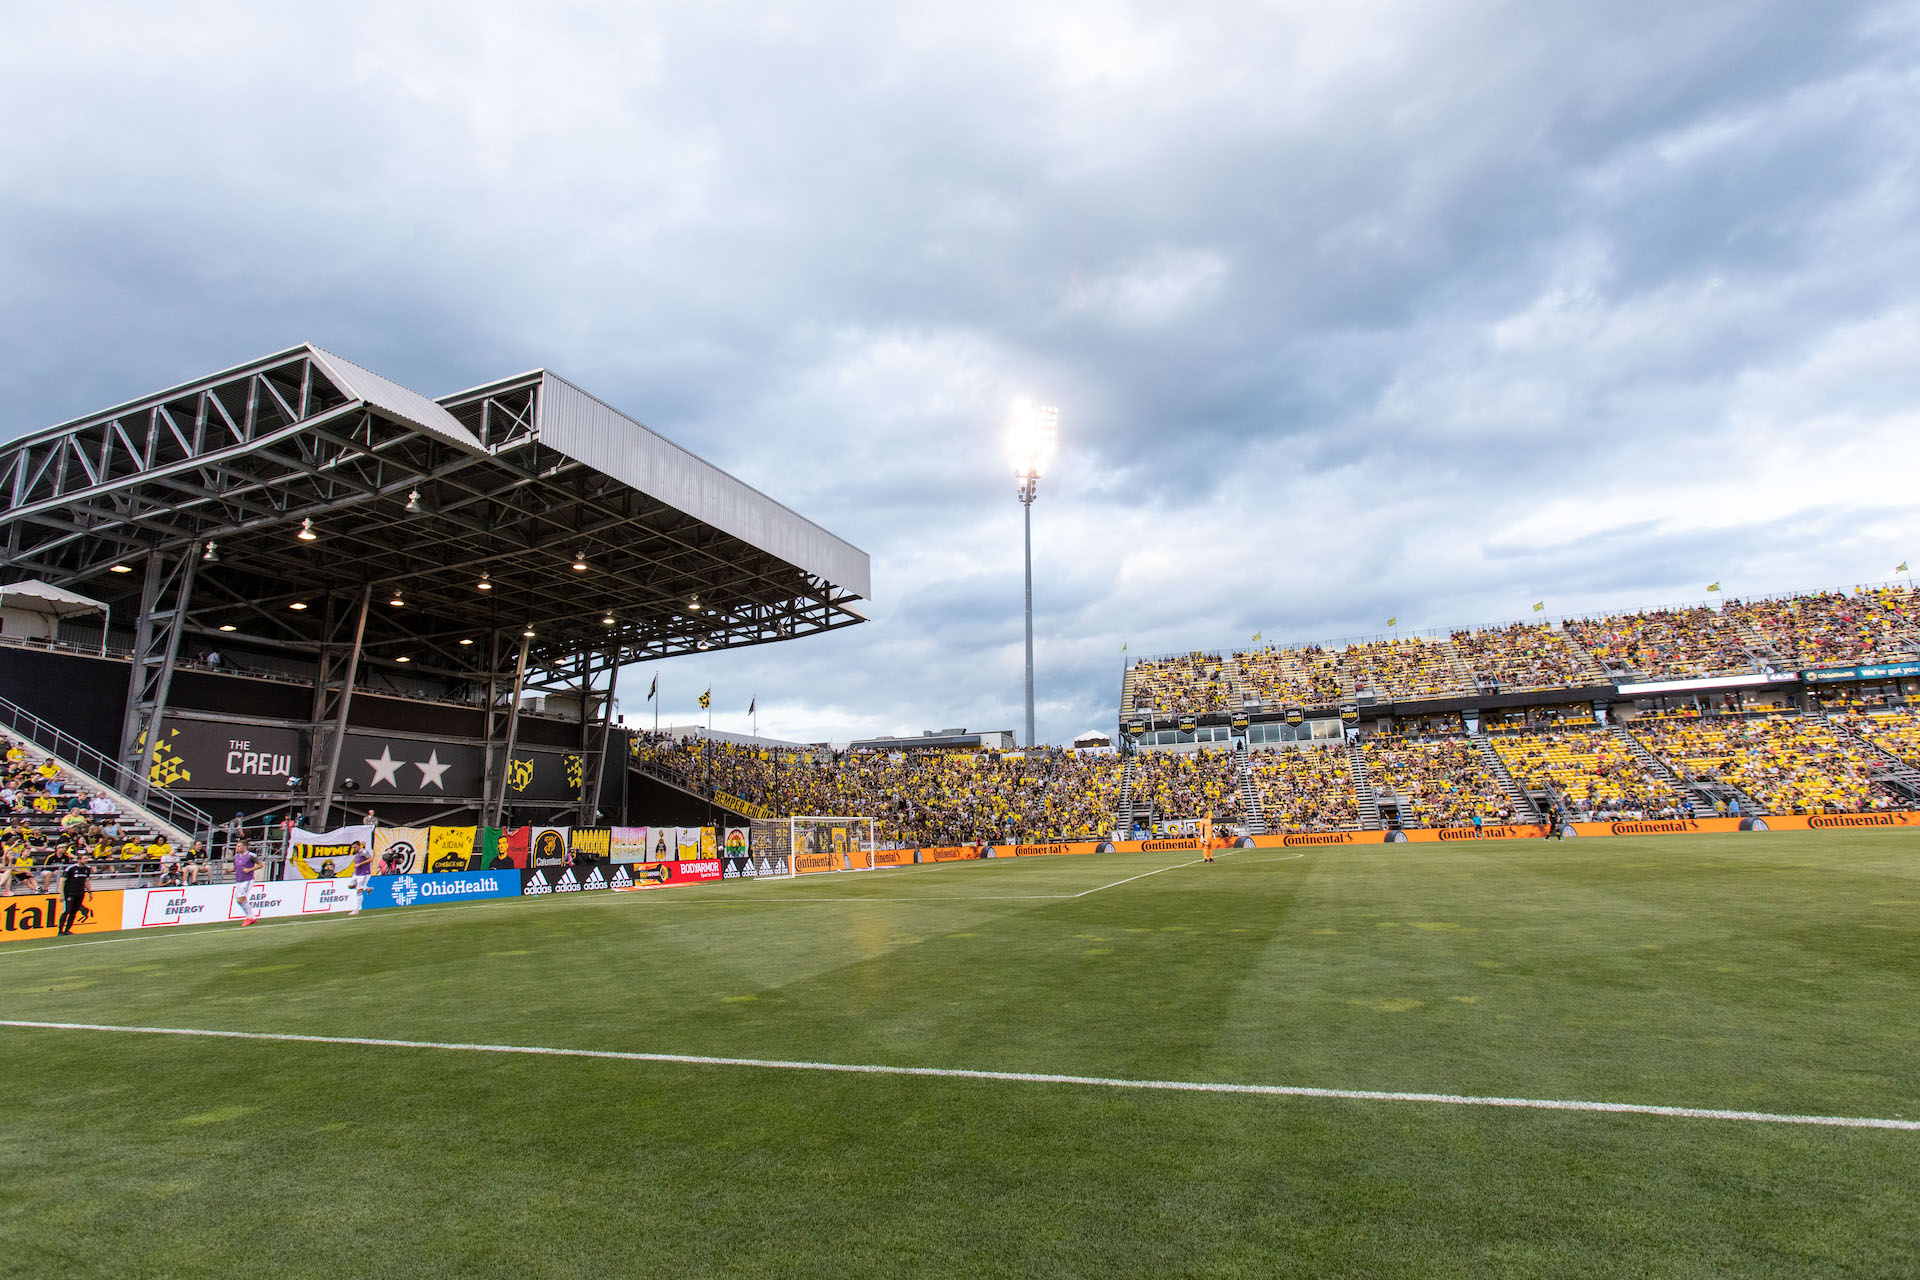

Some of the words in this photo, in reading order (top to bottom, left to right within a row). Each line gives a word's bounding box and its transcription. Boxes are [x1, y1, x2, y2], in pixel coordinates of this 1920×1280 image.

[1861, 668, 1887, 677] We've
[1888, 667, 1903, 676] got
[1903, 666, 1919, 675] you
[229, 739, 251, 750] THE
[226, 751, 291, 776] CREW
[714, 790, 745, 813] SEMPER
[1807, 813, 1894, 829] Continental
[1611, 821, 1687, 835] Continental
[433, 833, 443, 844] WE
[1283, 834, 1344, 847] Continental
[441, 841, 464, 849] AIDAN
[1141, 839, 1197, 851] Continental
[536, 857, 562, 866] Columbus
[680, 862, 719, 874] BODYARMOR
[741, 869, 757, 877] adidas
[723, 870, 740, 878] adidas
[421, 878, 499, 896] OhioHealth
[555, 882, 581, 893] adidas
[583, 881, 608, 891] adidas
[609, 879, 634, 888] adidas
[321, 888, 336, 896] AEP
[523, 884, 552, 895] adidas
[167, 898, 187, 906] AEP
[250, 893, 267, 901] AEP
[319, 895, 349, 903] ENERGY
[0, 898, 58, 932] tal
[165, 904, 205, 915] ENERGY
